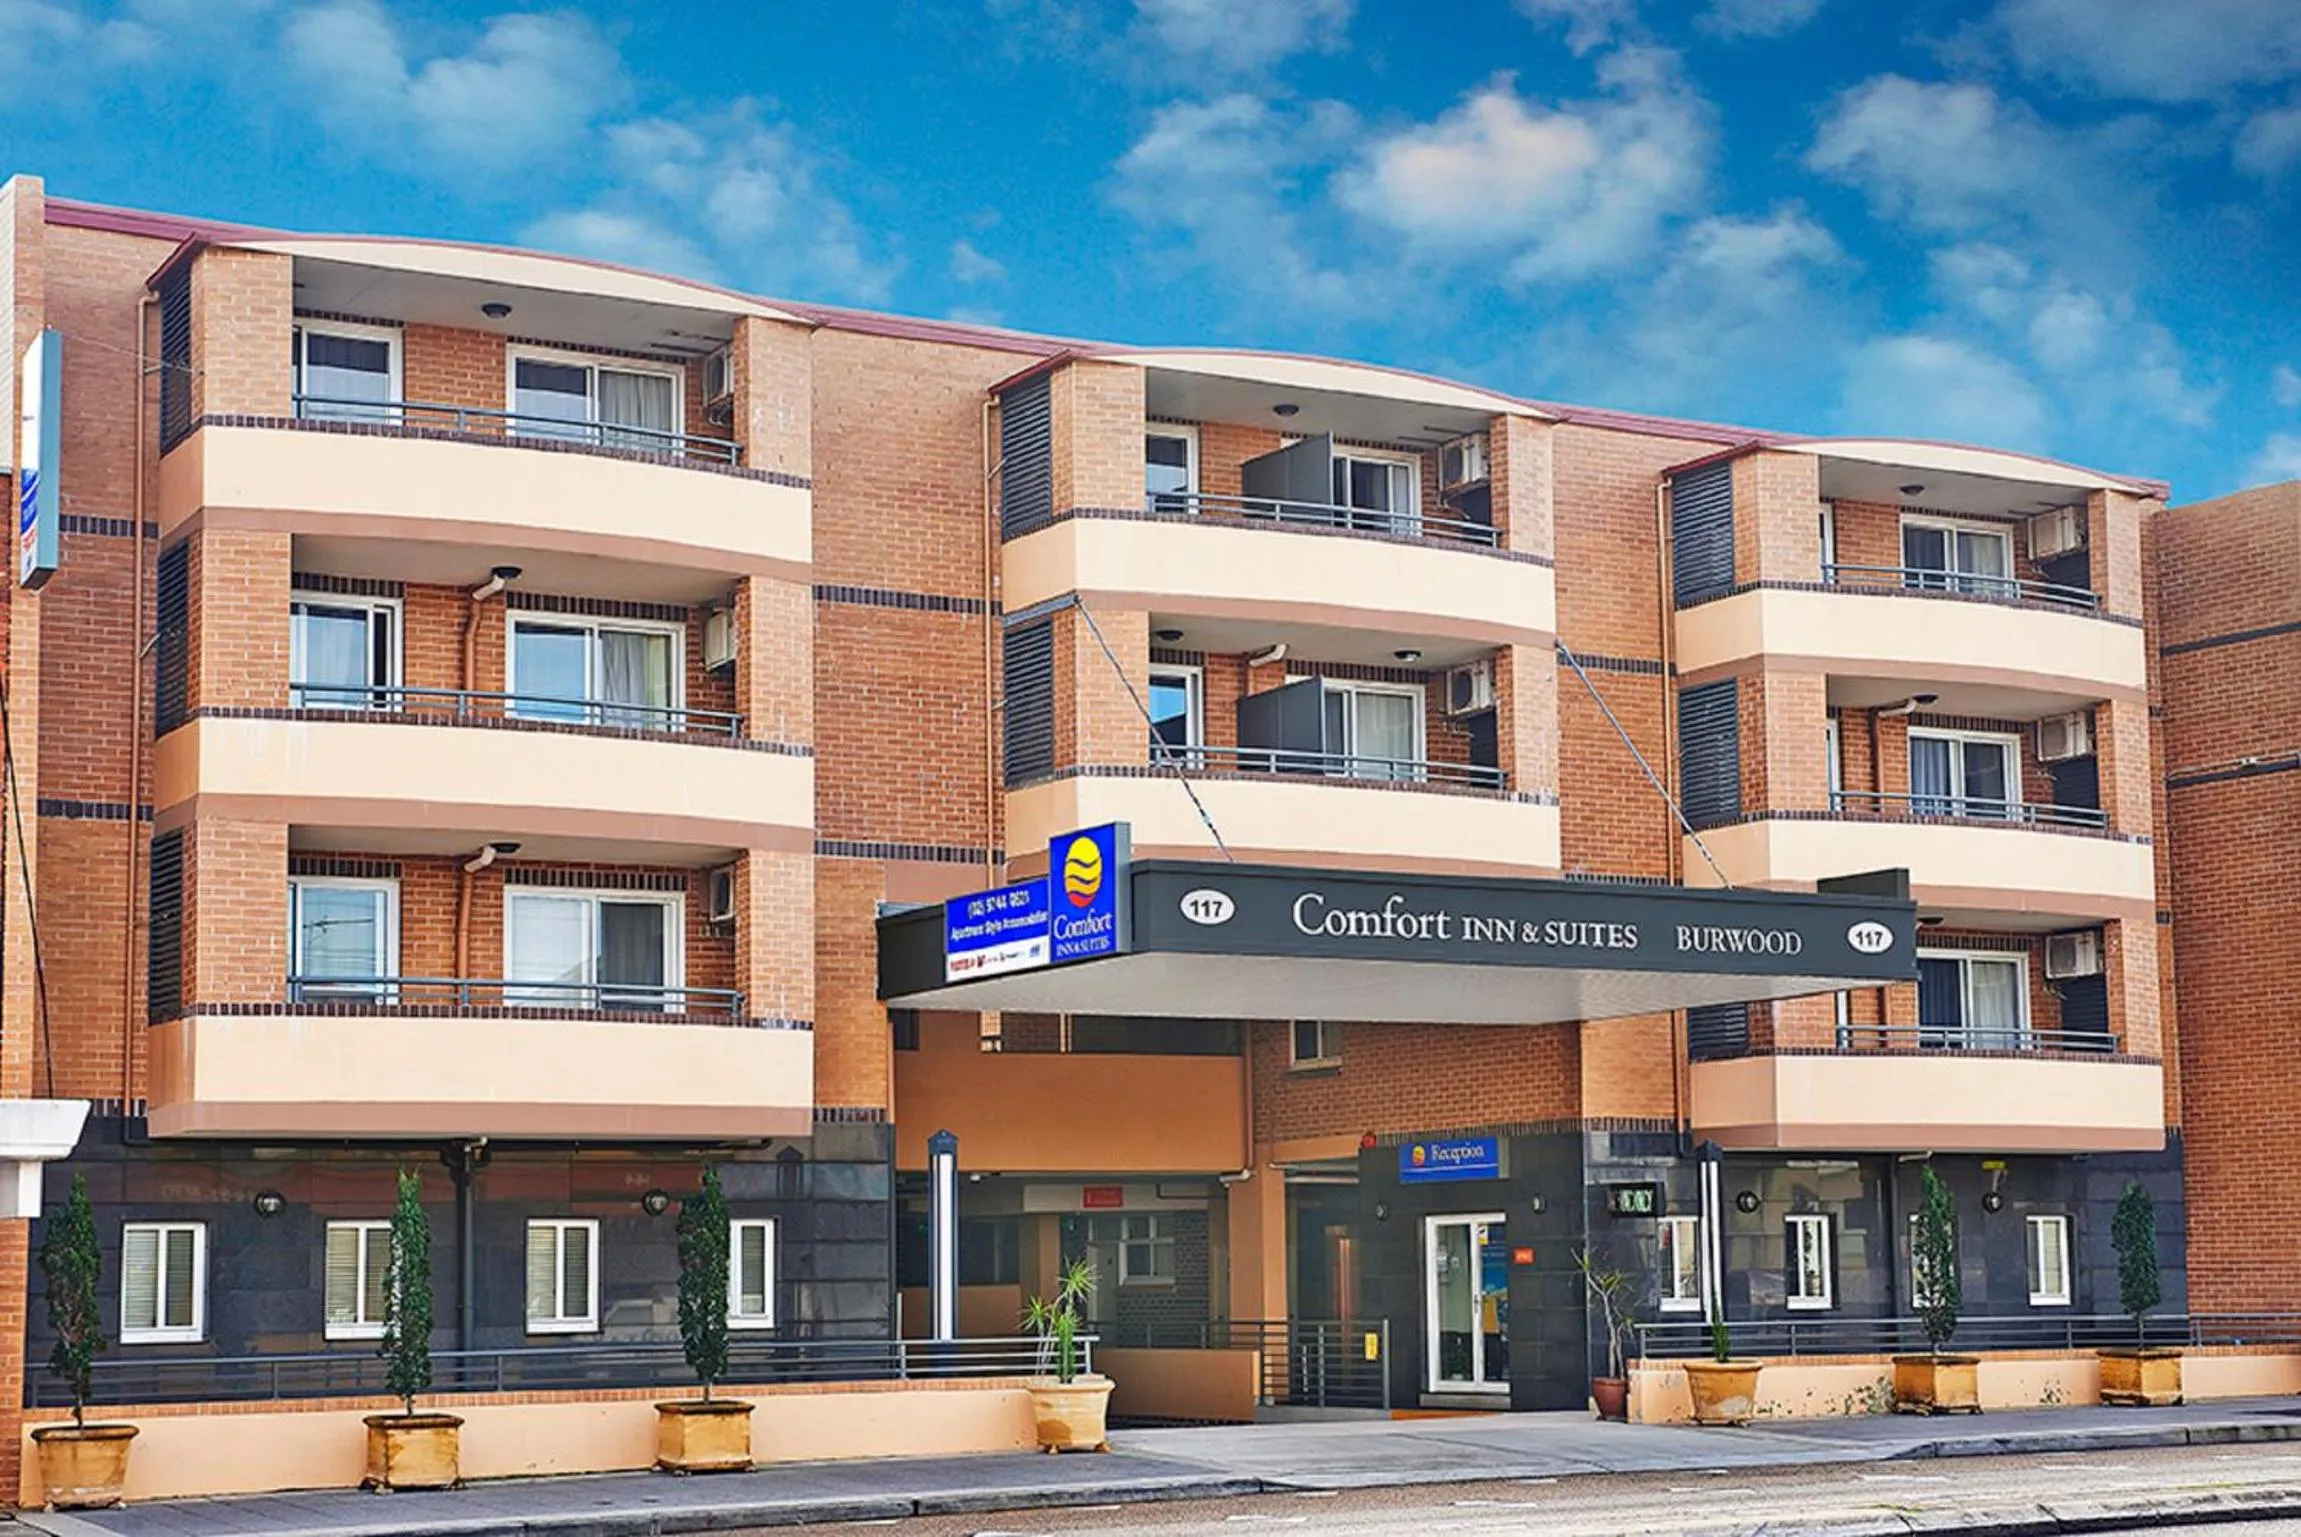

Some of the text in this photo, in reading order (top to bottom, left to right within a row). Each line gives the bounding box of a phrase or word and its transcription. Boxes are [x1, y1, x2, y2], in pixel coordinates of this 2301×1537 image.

[1189, 898, 1223, 918] 117
[1292, 892, 1639, 949] Comfort INN & SUITES
[1053, 907, 1113, 941] Comfort
[1675, 924, 1802, 955] BURWOOD
[1855, 930, 1884, 947] 117
